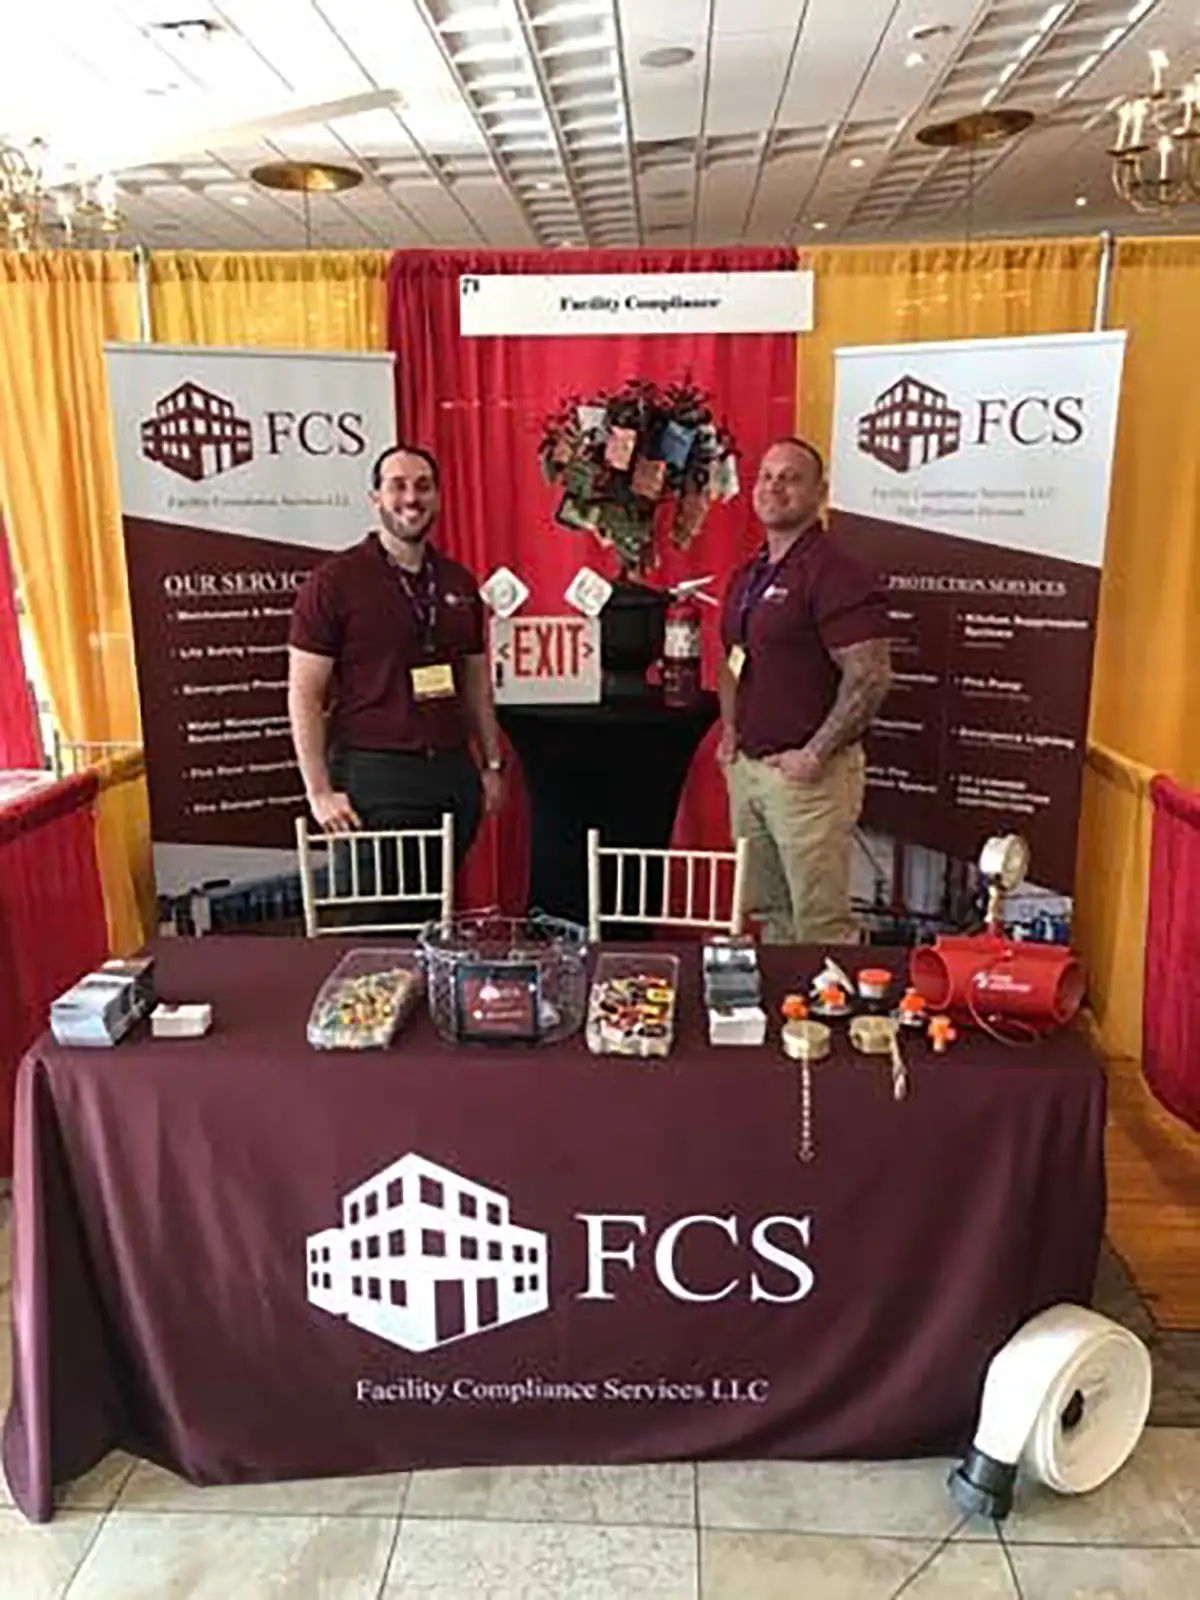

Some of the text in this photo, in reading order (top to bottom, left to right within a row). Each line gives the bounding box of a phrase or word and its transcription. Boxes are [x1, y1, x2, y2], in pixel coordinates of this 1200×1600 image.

[265, 411, 367, 456] FCS
[972, 396, 1085, 446] FCS
[164, 574, 217, 596] OUR
[513, 623, 584, 678] EXIT
[573, 1213, 816, 1304] FCS
[355, 1378, 770, 1404] Facility Compliance Services LLC
